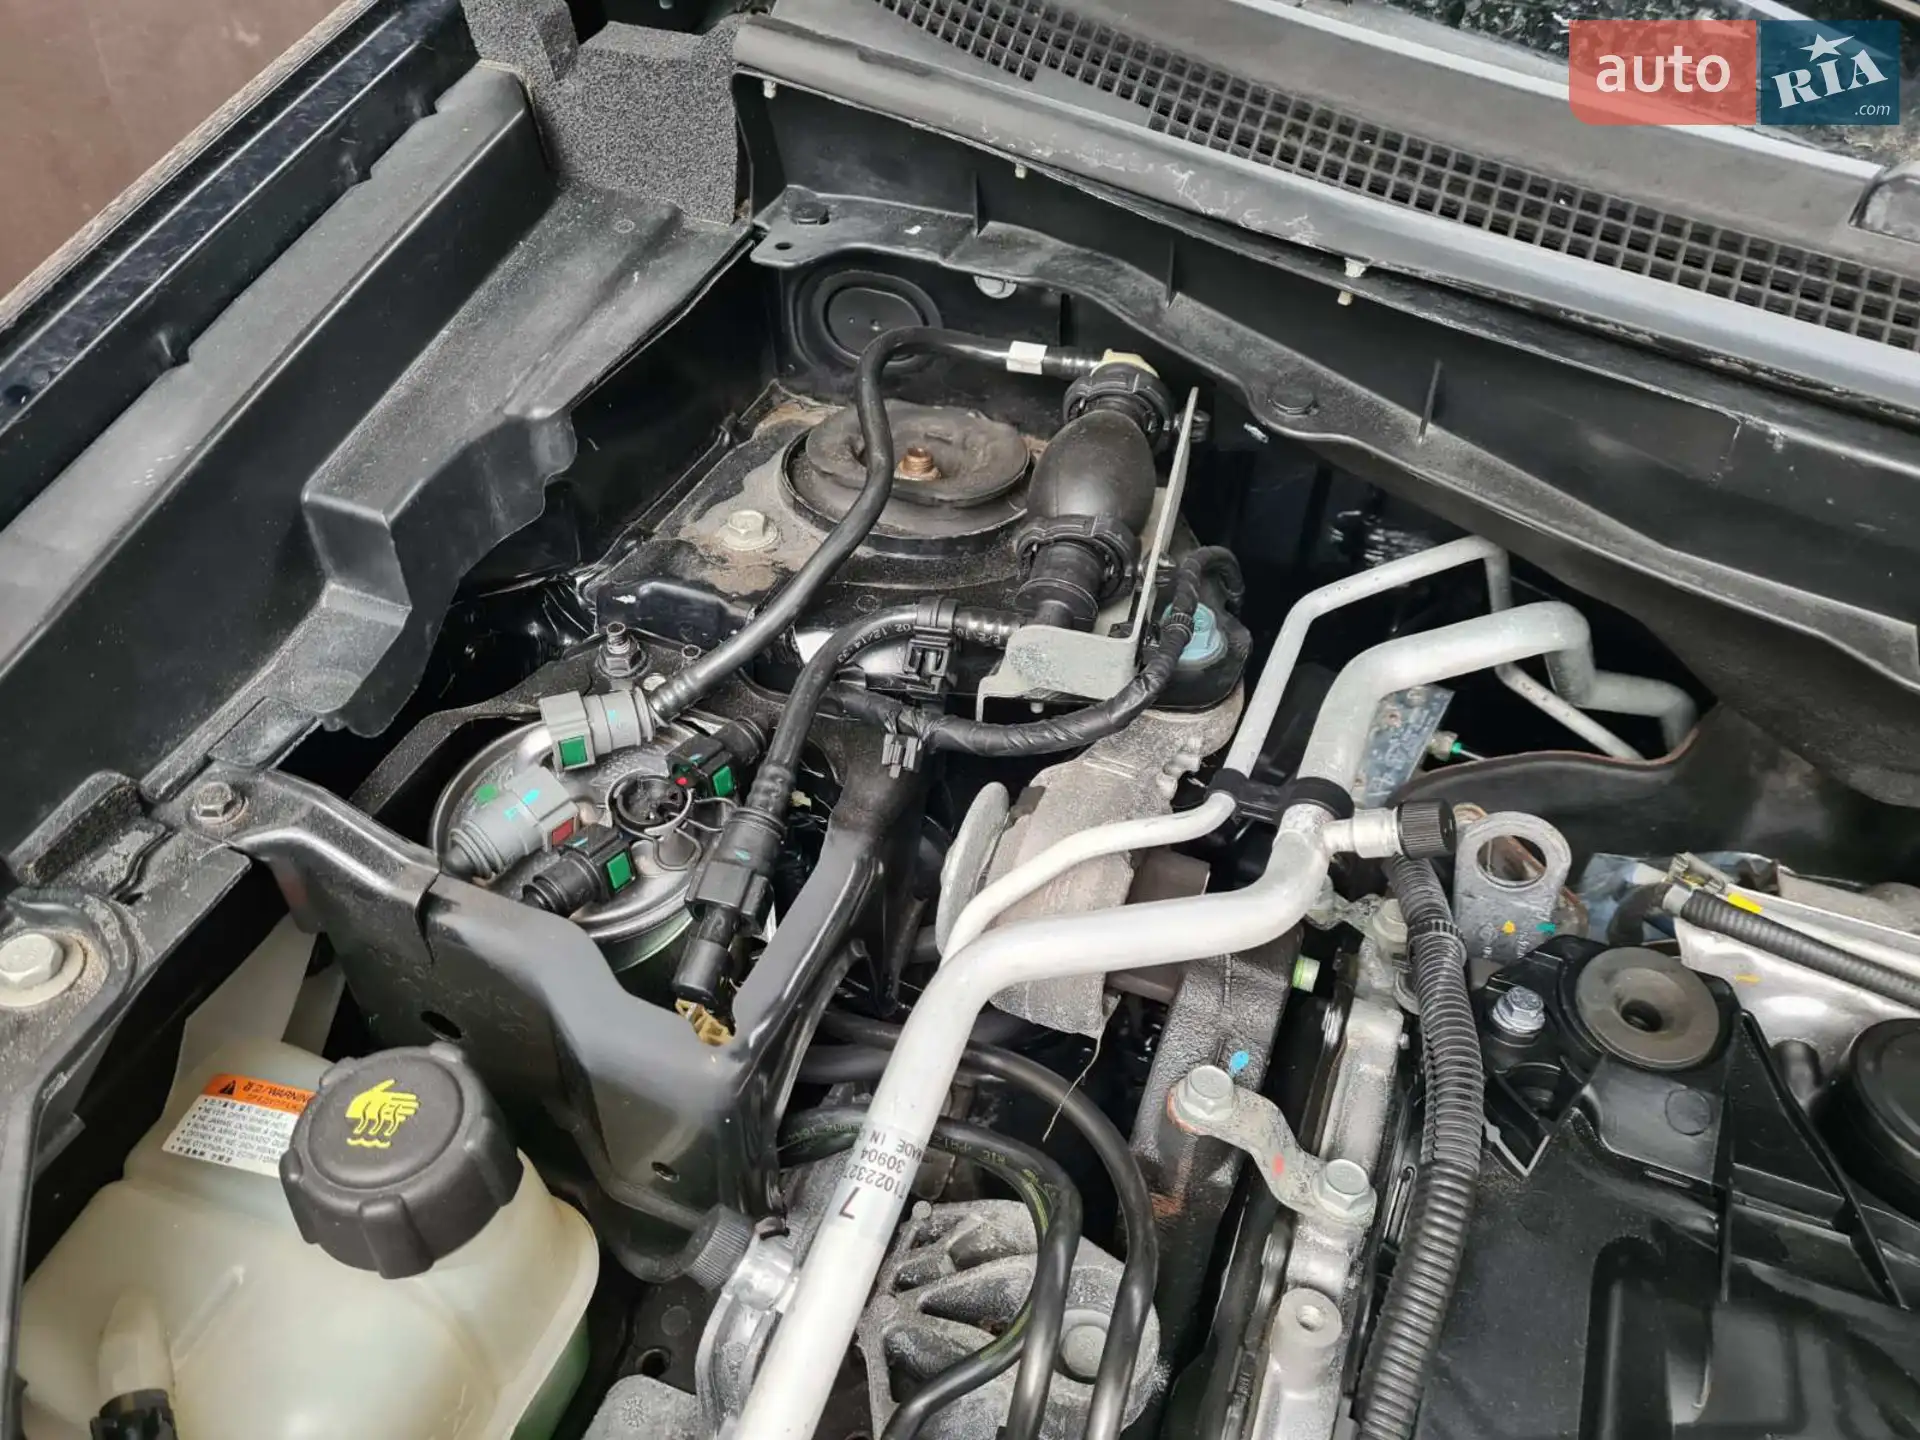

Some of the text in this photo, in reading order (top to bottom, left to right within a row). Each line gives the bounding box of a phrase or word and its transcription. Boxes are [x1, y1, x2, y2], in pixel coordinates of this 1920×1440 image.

[869, 1130, 887, 1146] IN
[860, 1148, 906, 1174] 30904
[839, 1186, 861, 1220] 7
